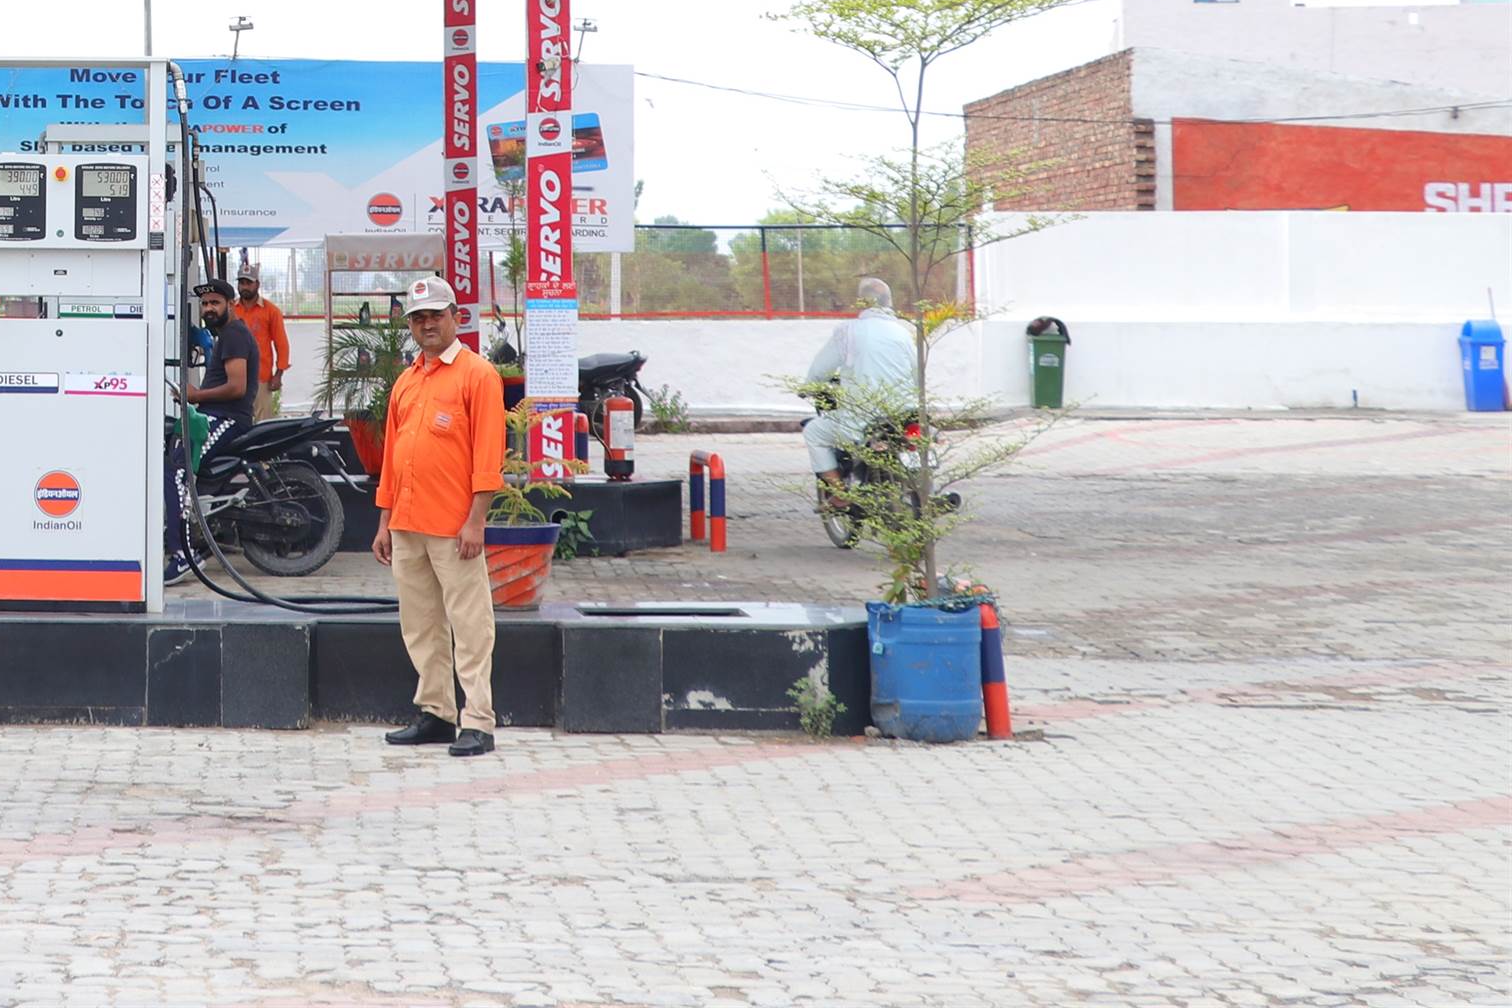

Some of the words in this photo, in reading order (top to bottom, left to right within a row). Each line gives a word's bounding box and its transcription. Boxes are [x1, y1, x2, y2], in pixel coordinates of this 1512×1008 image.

[70, 69, 137, 83] Move
[214, 70, 281, 85] Fleet
[56, 95, 106, 109] The
[203, 95, 232, 110] Of
[241, 96, 260, 110] A
[268, 96, 361, 112] Screen
[453, 64, 470, 151] SERVO
[268, 123, 288, 134] of
[220, 208, 277, 217] Insurance
[454, 200, 471, 295] SERVO
[354, 252, 435, 269] SERVO
[70, 305, 102, 313] PETROL
[129, 305, 143, 313] DIE
[542, 416, 564, 478] SER
[33, 520, 82, 531] IndianOil
